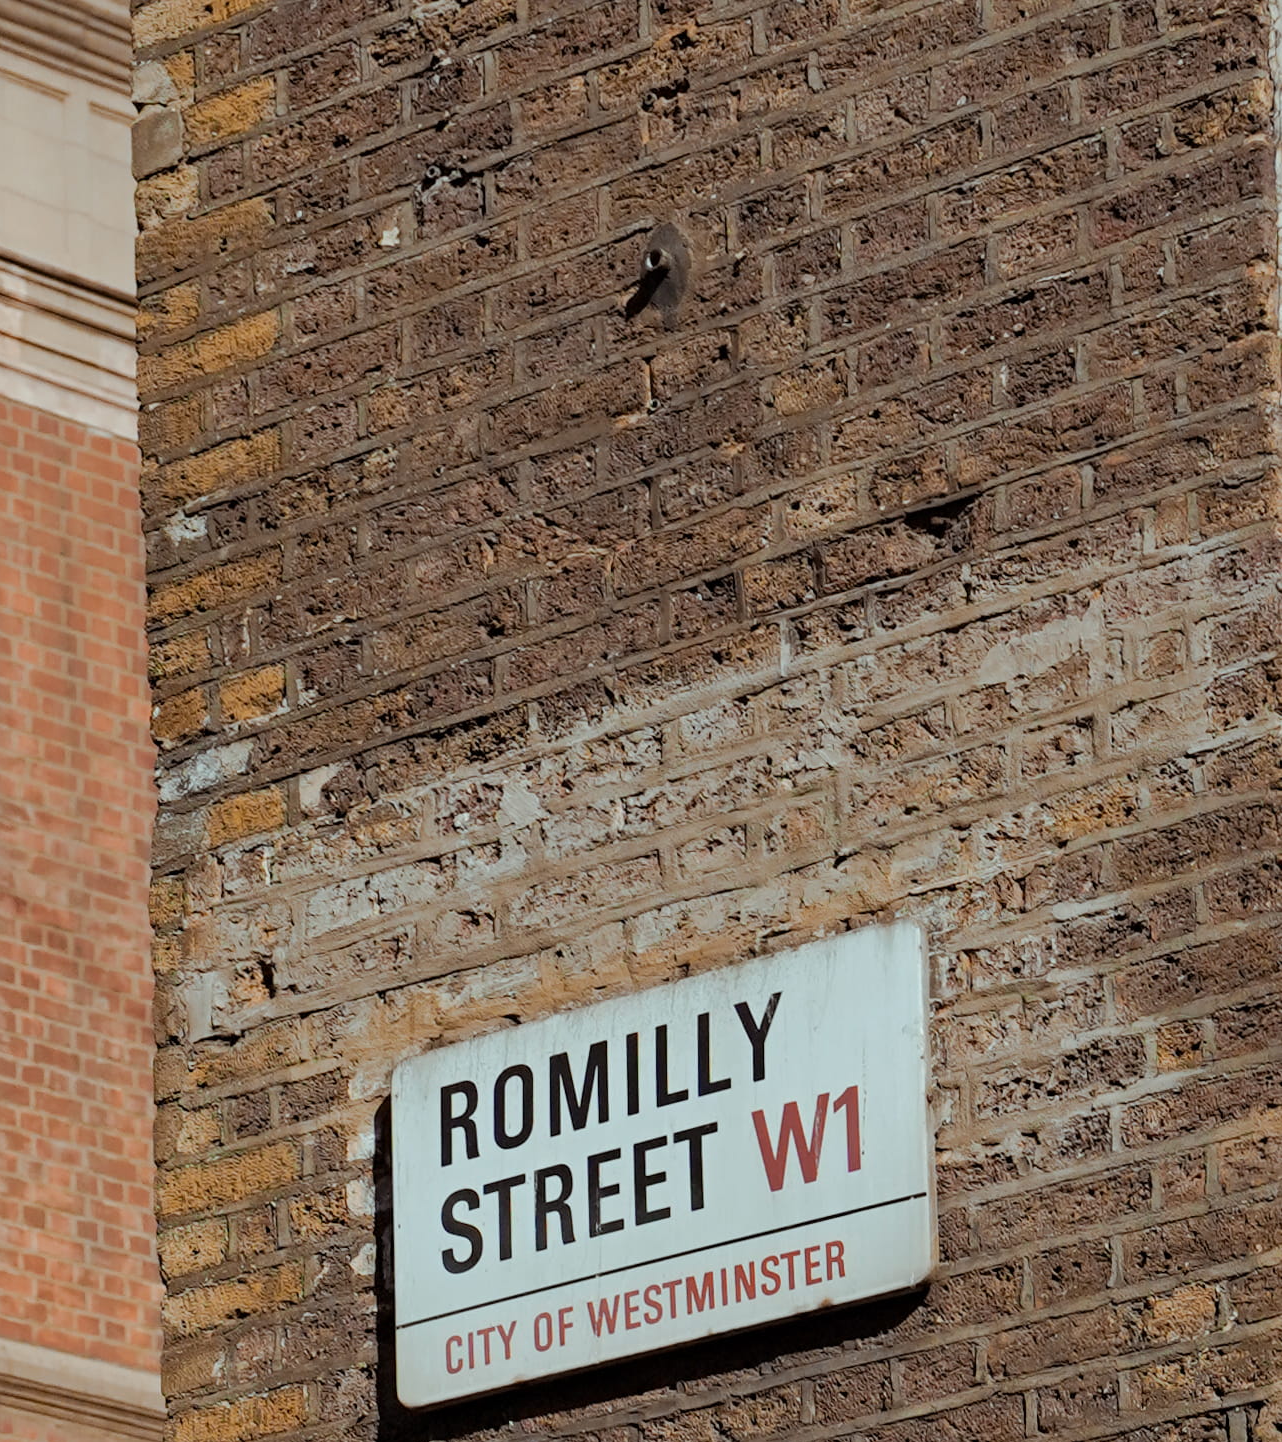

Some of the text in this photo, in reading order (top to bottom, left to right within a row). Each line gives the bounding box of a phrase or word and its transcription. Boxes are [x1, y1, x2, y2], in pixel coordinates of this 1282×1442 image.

[440, 992, 782, 1167] ROMILLY
[441, 1085, 862, 1274] STREET W1
[445, 1239, 846, 1375] CITY OF WESTMINSTER
